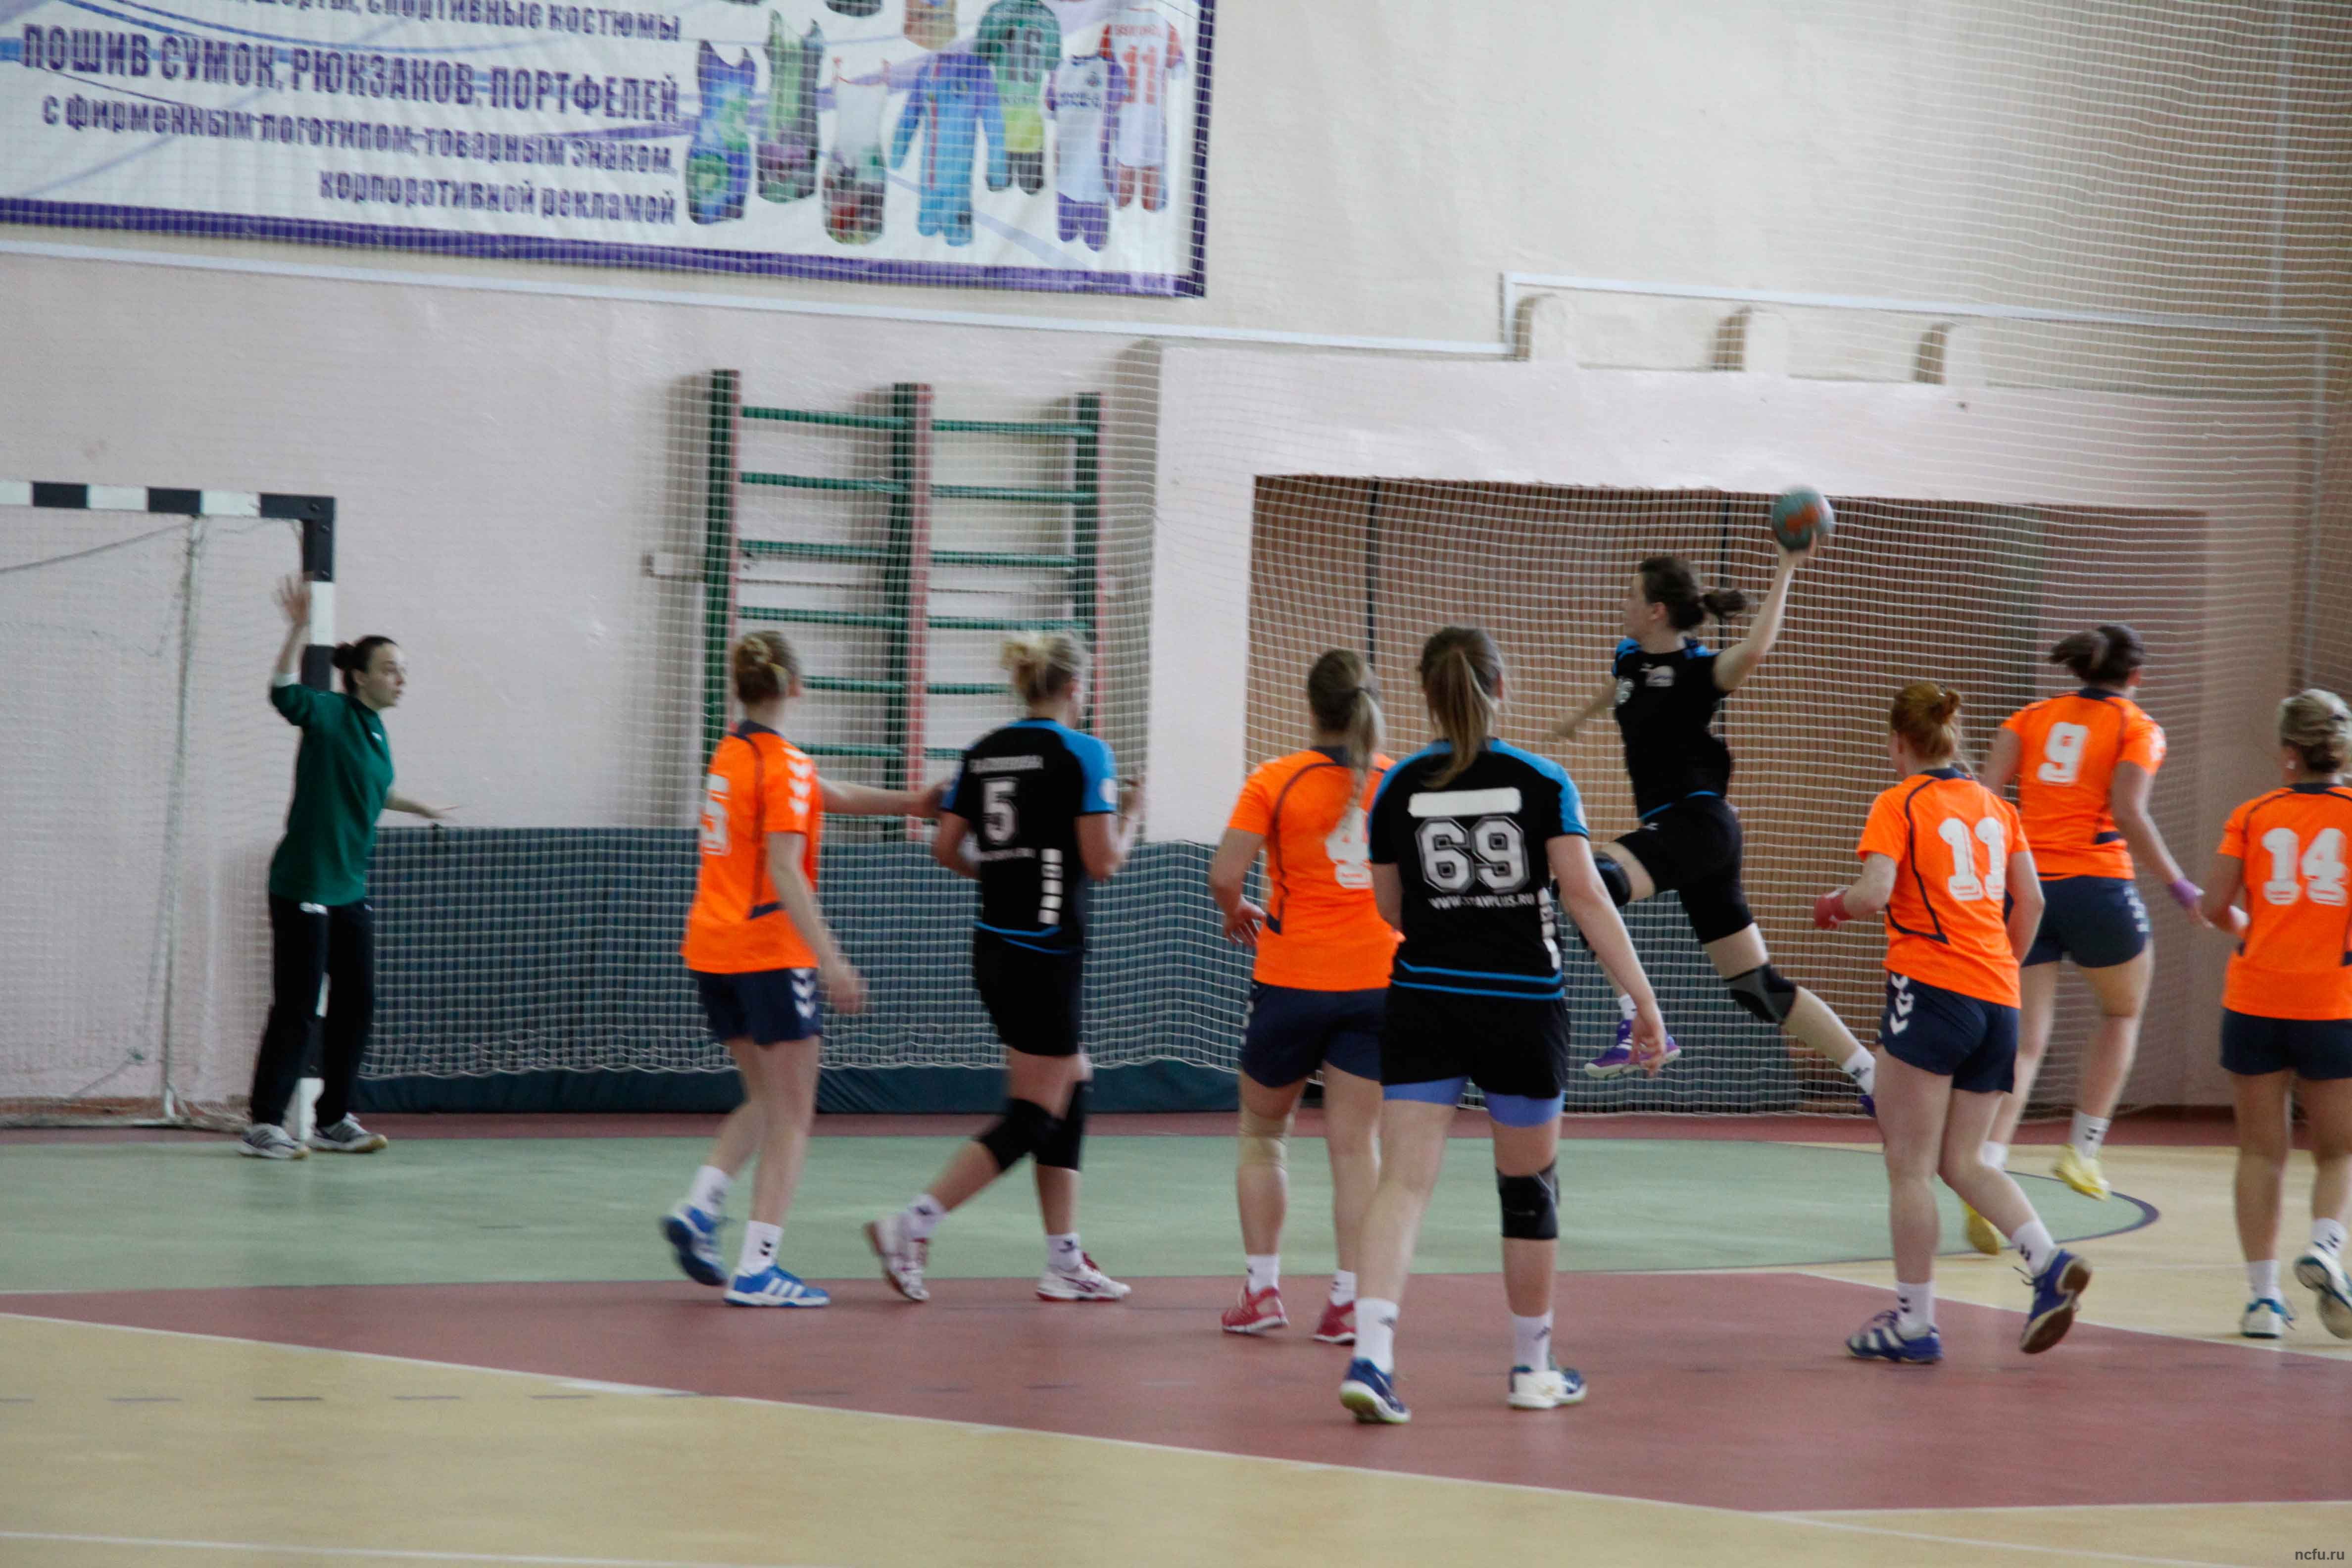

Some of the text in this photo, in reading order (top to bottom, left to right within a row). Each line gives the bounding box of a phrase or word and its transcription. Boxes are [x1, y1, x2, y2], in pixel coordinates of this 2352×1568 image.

[548, 4, 681, 42] костюмы
[24, 24, 680, 122] ПОШИВ СУМОК, РЮКЗАКОВ, ПОРТФЕЛЕЙ
[42, 95, 59, 125] с
[319, 171, 676, 224] корпоративной рекламой
[2037, 721, 2090, 786] 9
[982, 777, 1018, 845] 5
[1415, 816, 1530, 894] 69
[1938, 818, 2007, 901] 11
[2262, 827, 2349, 907] 14
